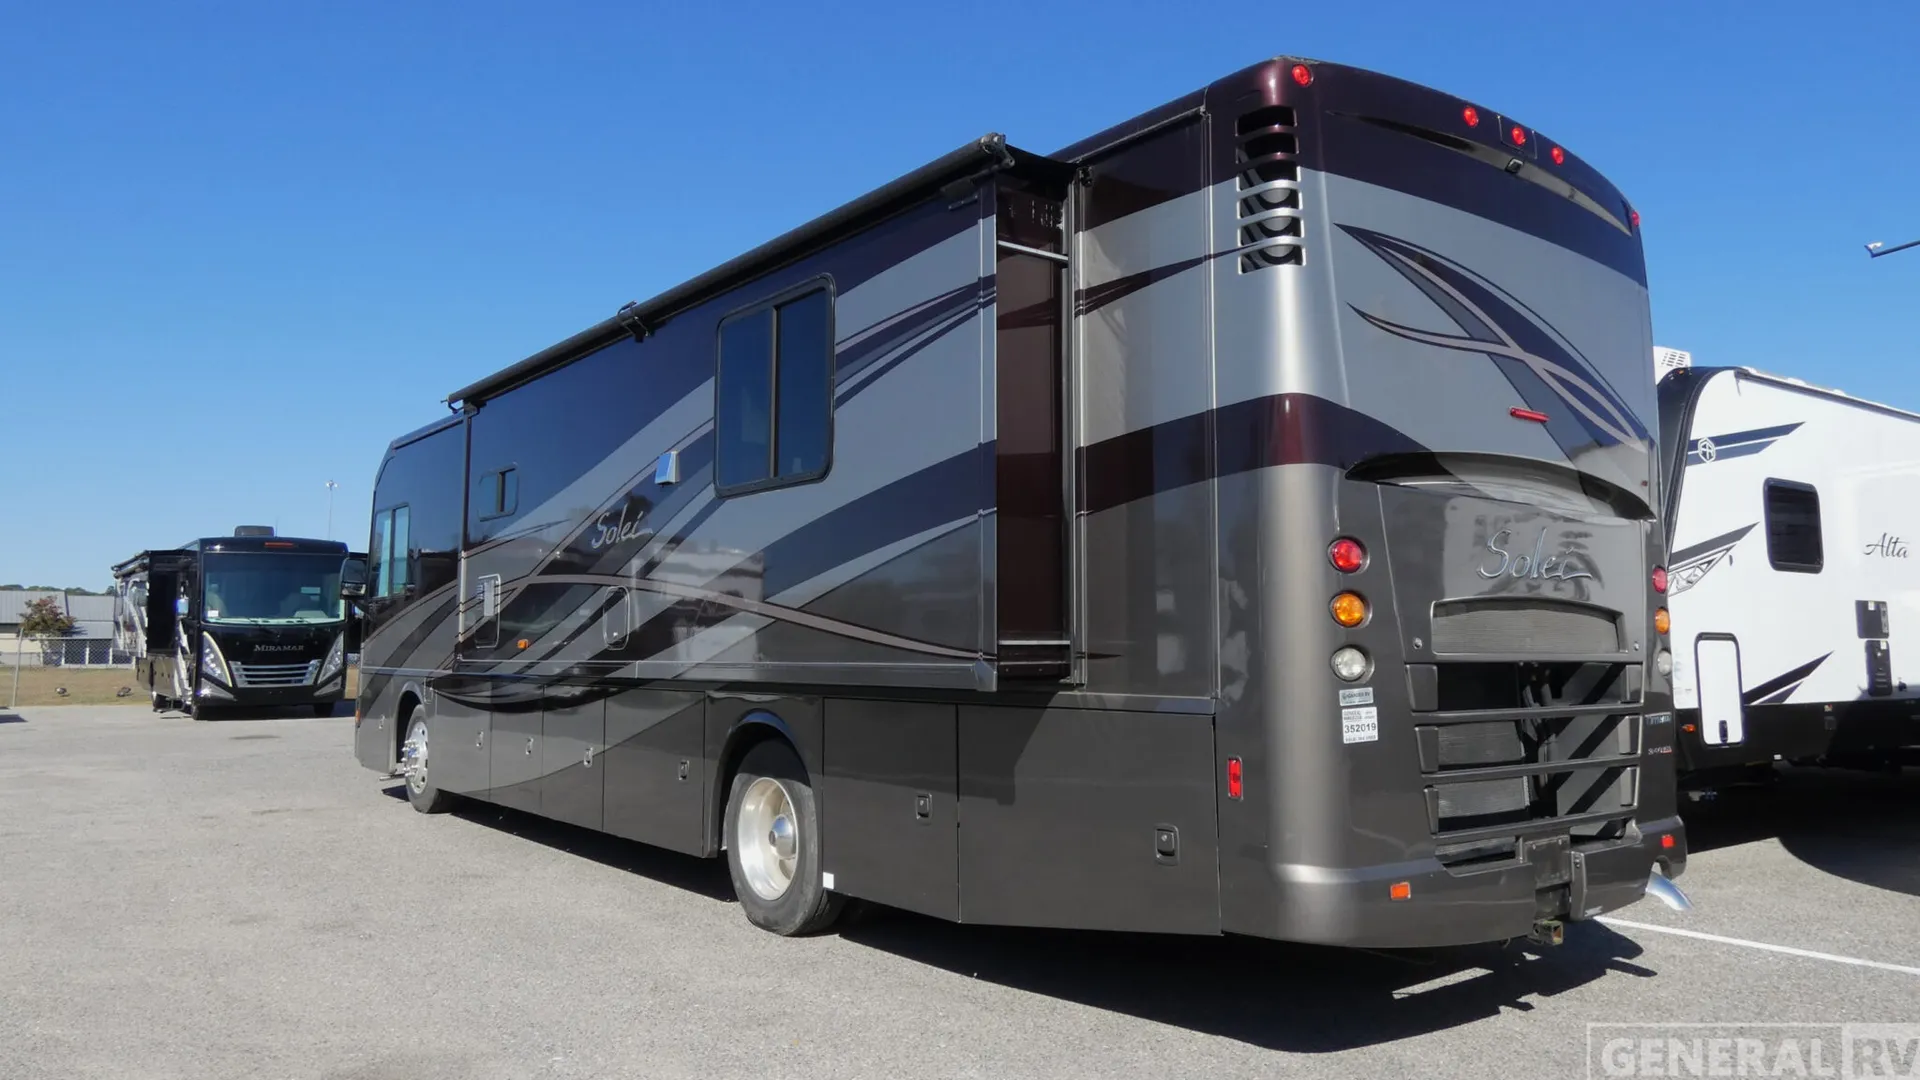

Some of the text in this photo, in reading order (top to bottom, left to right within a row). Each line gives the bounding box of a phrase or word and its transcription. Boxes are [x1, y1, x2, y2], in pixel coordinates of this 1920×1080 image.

[591, 503, 653, 549] Solei
[1477, 526, 1595, 579] Solei
[1863, 532, 1910, 558] Alta
[1344, 722, 1377, 734] 352019
